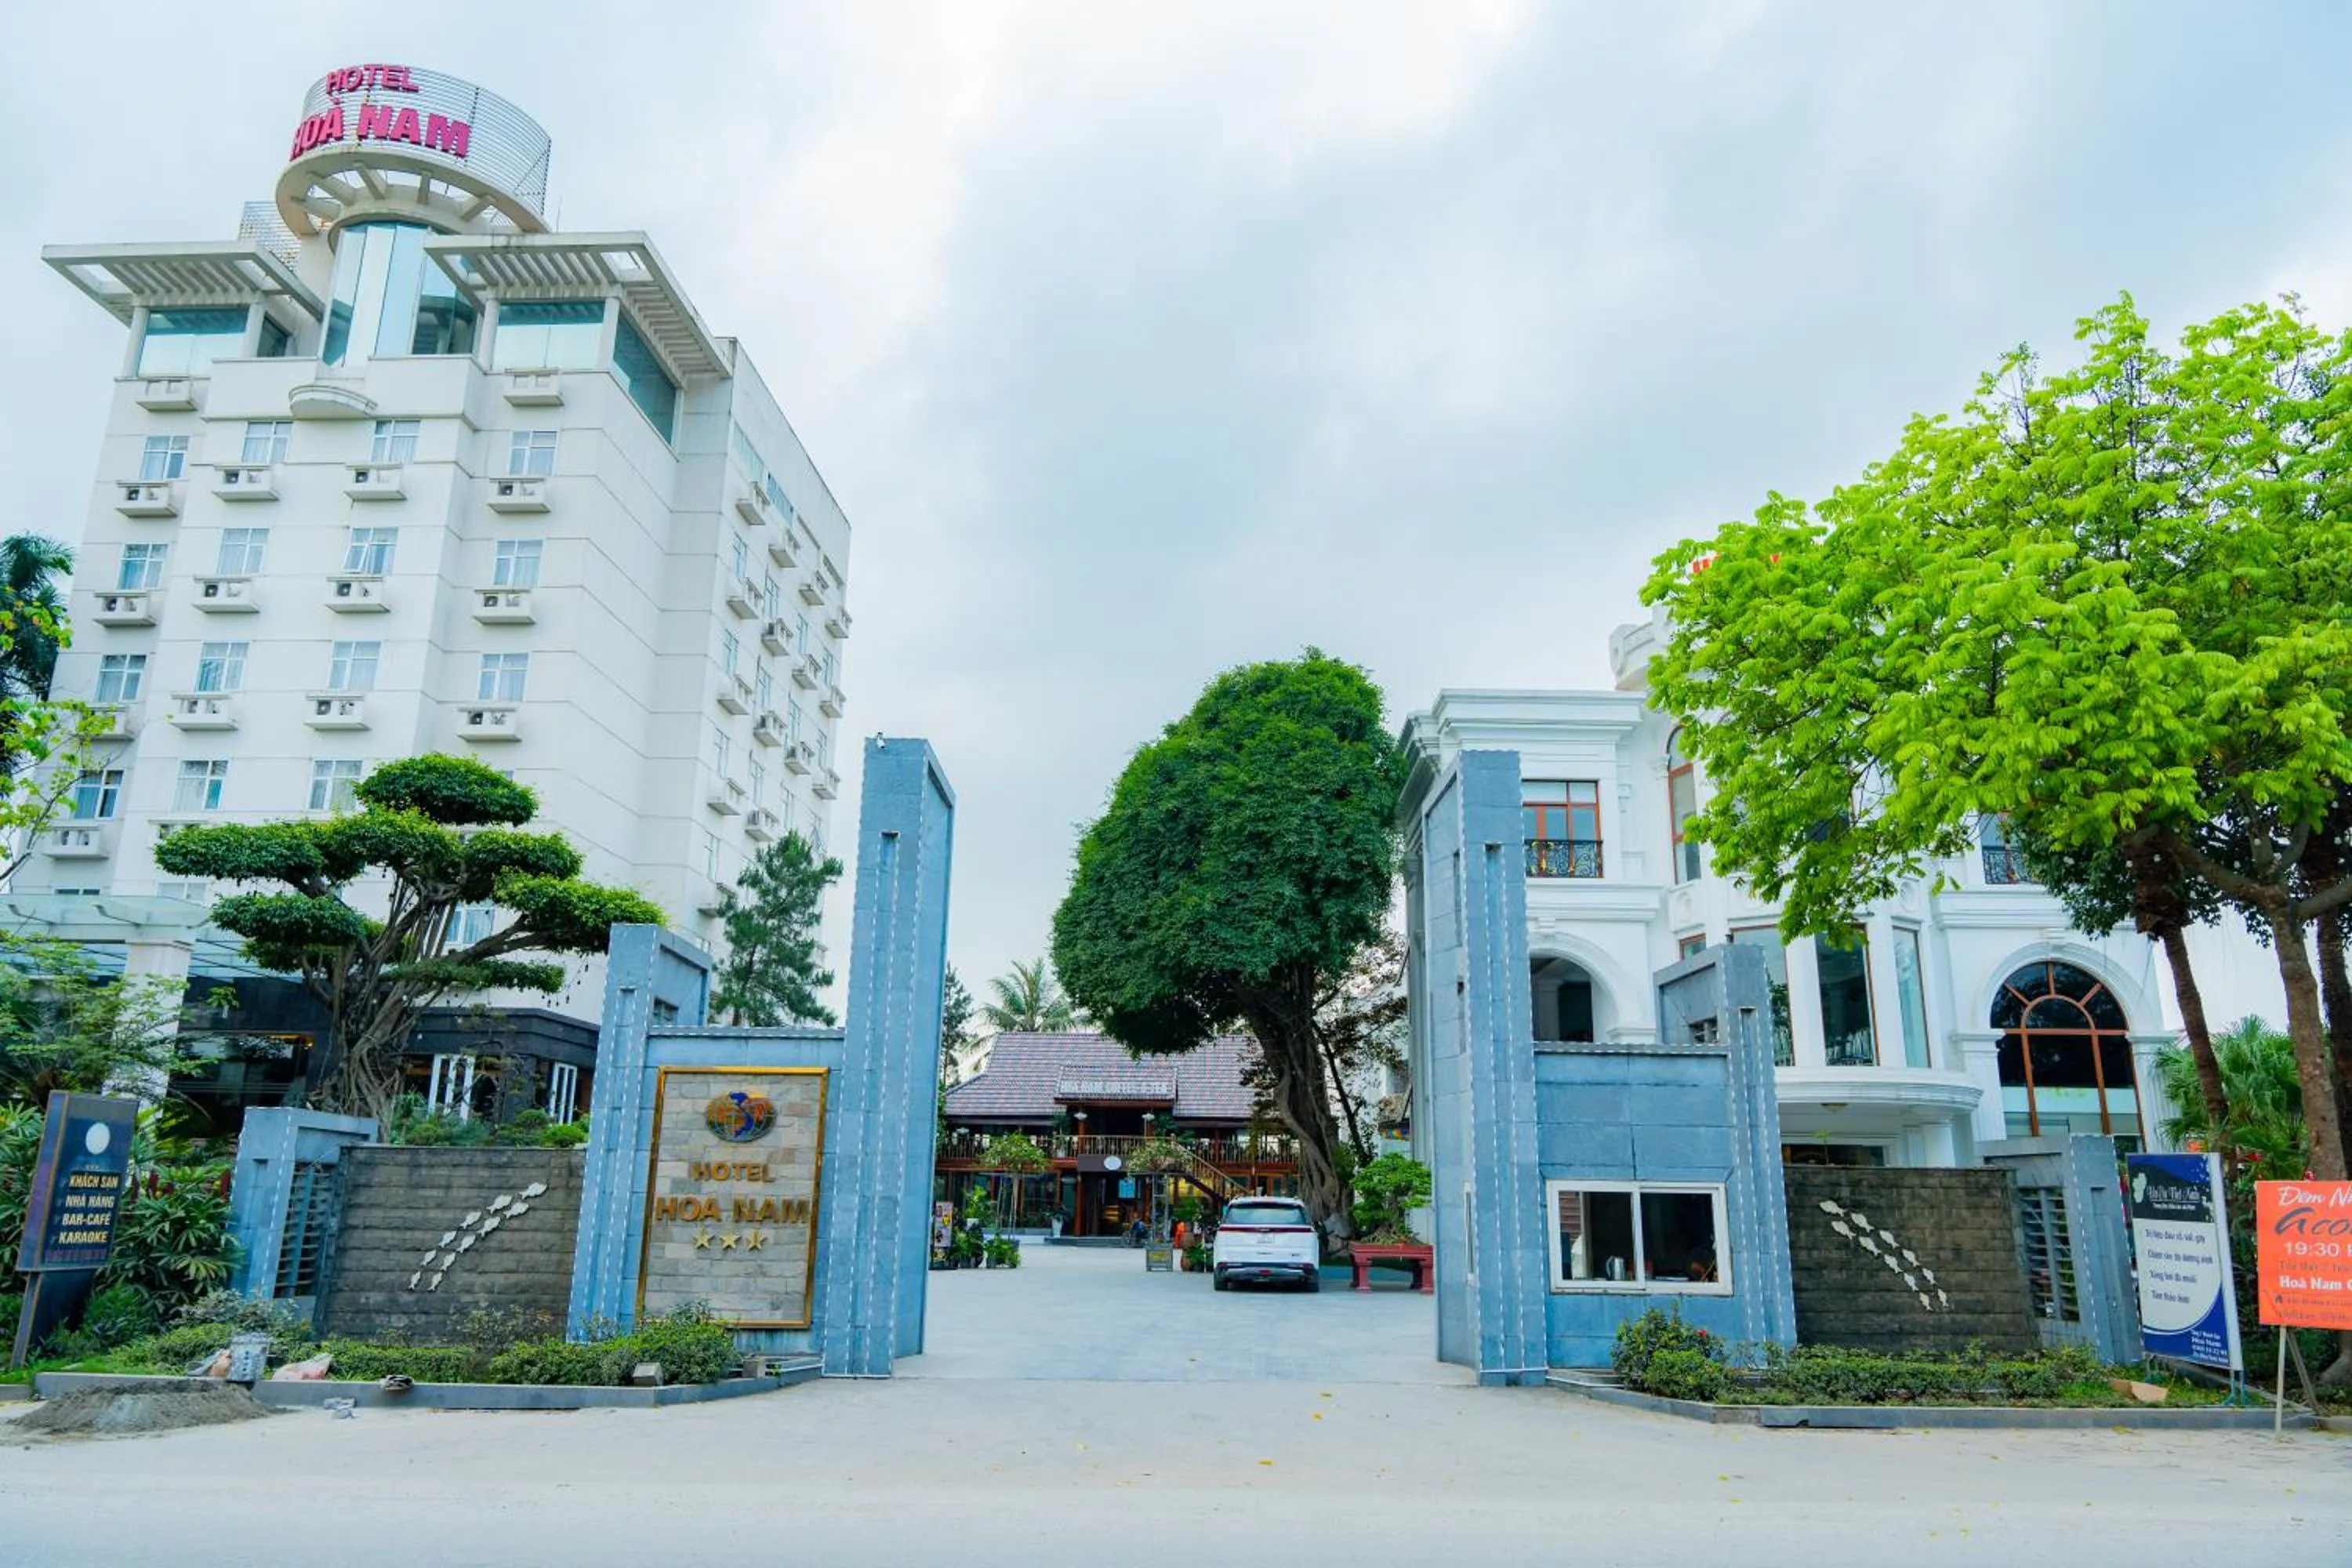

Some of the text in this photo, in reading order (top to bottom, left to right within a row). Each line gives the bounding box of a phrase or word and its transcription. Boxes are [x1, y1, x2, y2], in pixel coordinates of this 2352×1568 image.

[326, 64, 419, 95] HOTEL
[357, 103, 470, 158] NAM
[689, 1162, 776, 1183] HOTEL
[733, 1197, 810, 1224] NAM
[59, 1231, 108, 1244] KARAOKE
[2284, 1242, 2340, 1258] 19:30
[2310, 1277, 2343, 1290] Nam
